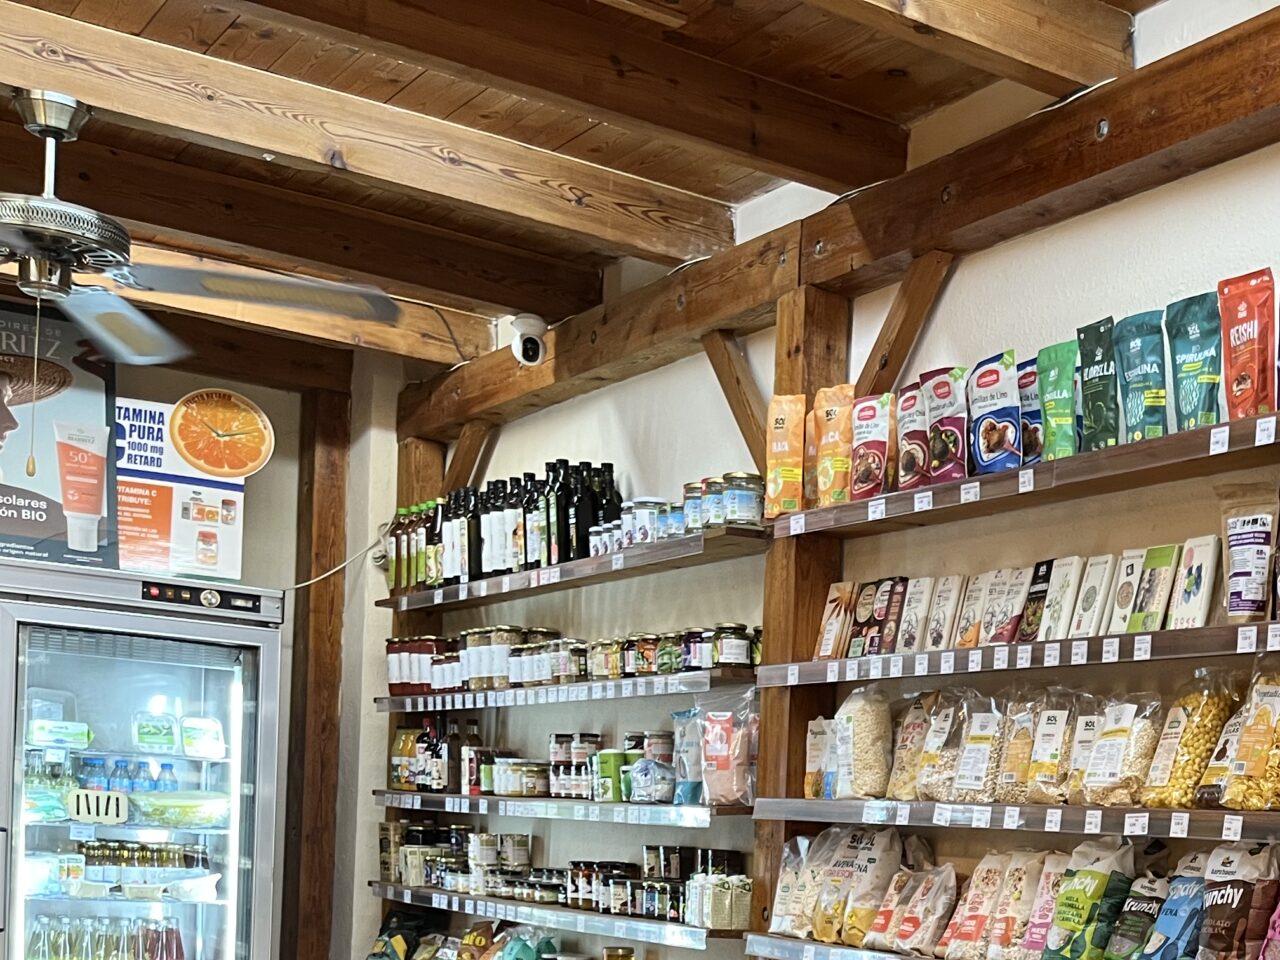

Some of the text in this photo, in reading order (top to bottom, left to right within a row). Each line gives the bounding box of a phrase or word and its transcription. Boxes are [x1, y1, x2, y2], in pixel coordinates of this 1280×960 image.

[1230, 319, 1258, 348] REISHI
[117, 406, 165, 426] TAMINA
[128, 424, 164, 442] PURA
[127, 440, 164, 456] 1000 mg
[127, 452, 162, 468] RETARD
[22, 510, 47, 522] BIO
